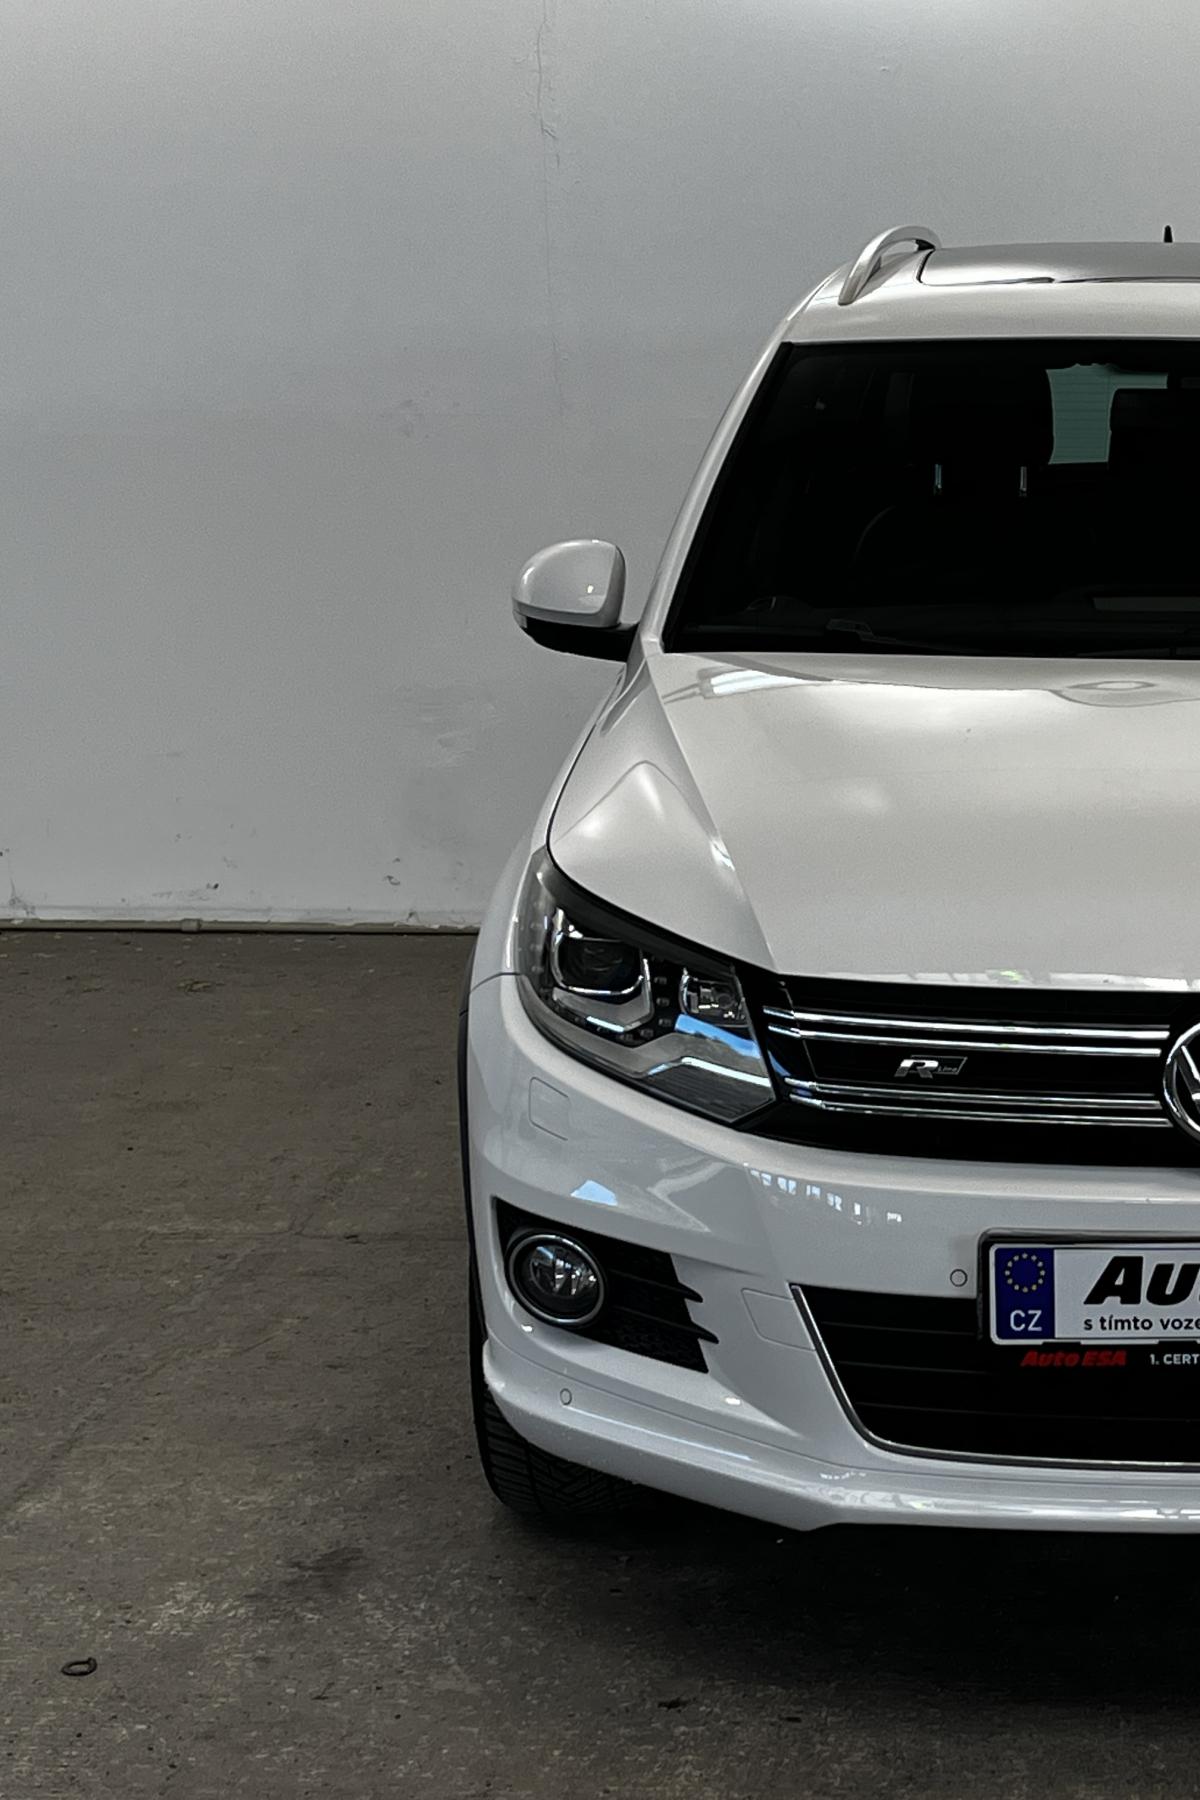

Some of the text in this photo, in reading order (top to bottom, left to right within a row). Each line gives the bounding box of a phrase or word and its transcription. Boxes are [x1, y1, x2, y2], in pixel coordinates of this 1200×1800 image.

[894, 1059, 939, 1078] R
[1009, 1309, 1043, 1332] CZ
[1083, 1318, 1094, 1331] s
[1099, 1314, 1153, 1331] tímto
[1020, 1350, 1128, 1367] Auto ESA
[1150, 1353, 1160, 1366] 1.
